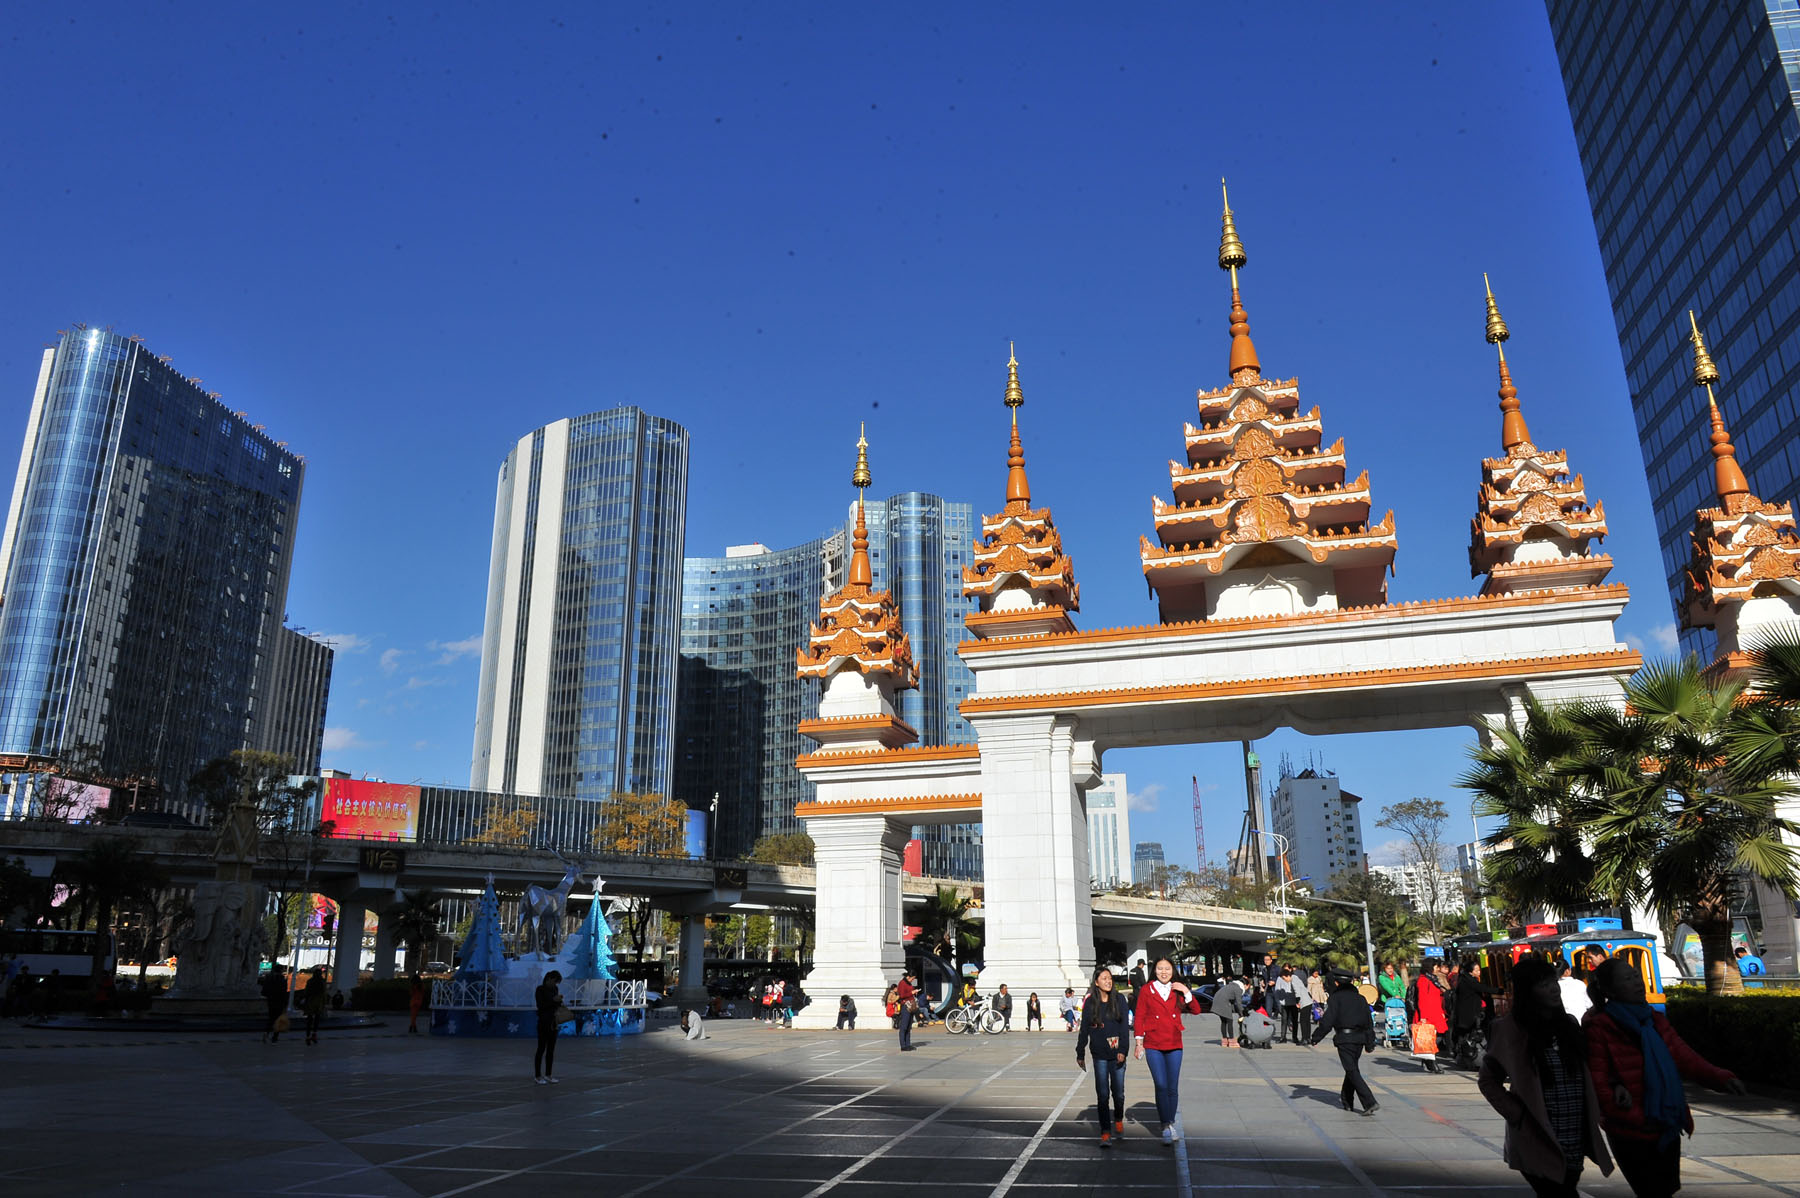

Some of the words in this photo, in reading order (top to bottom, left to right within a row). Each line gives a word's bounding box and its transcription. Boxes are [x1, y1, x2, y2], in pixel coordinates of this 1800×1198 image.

[336, 798, 408, 821] 社会主义核心价值观
